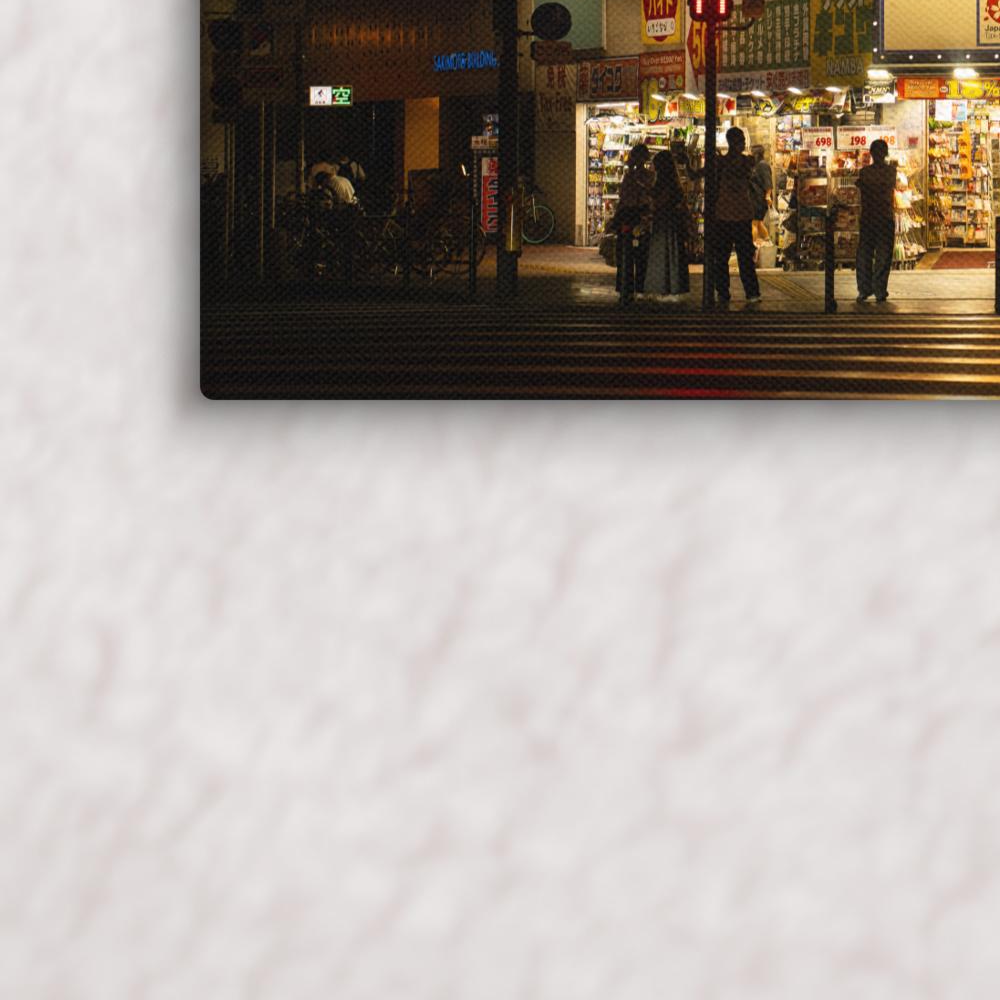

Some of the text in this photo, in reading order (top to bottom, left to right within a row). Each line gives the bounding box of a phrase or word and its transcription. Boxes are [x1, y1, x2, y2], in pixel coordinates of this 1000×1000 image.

[332, 86, 351, 105] 空
[815, 137, 832, 147] 698
[850, 135, 867, 146] 198
